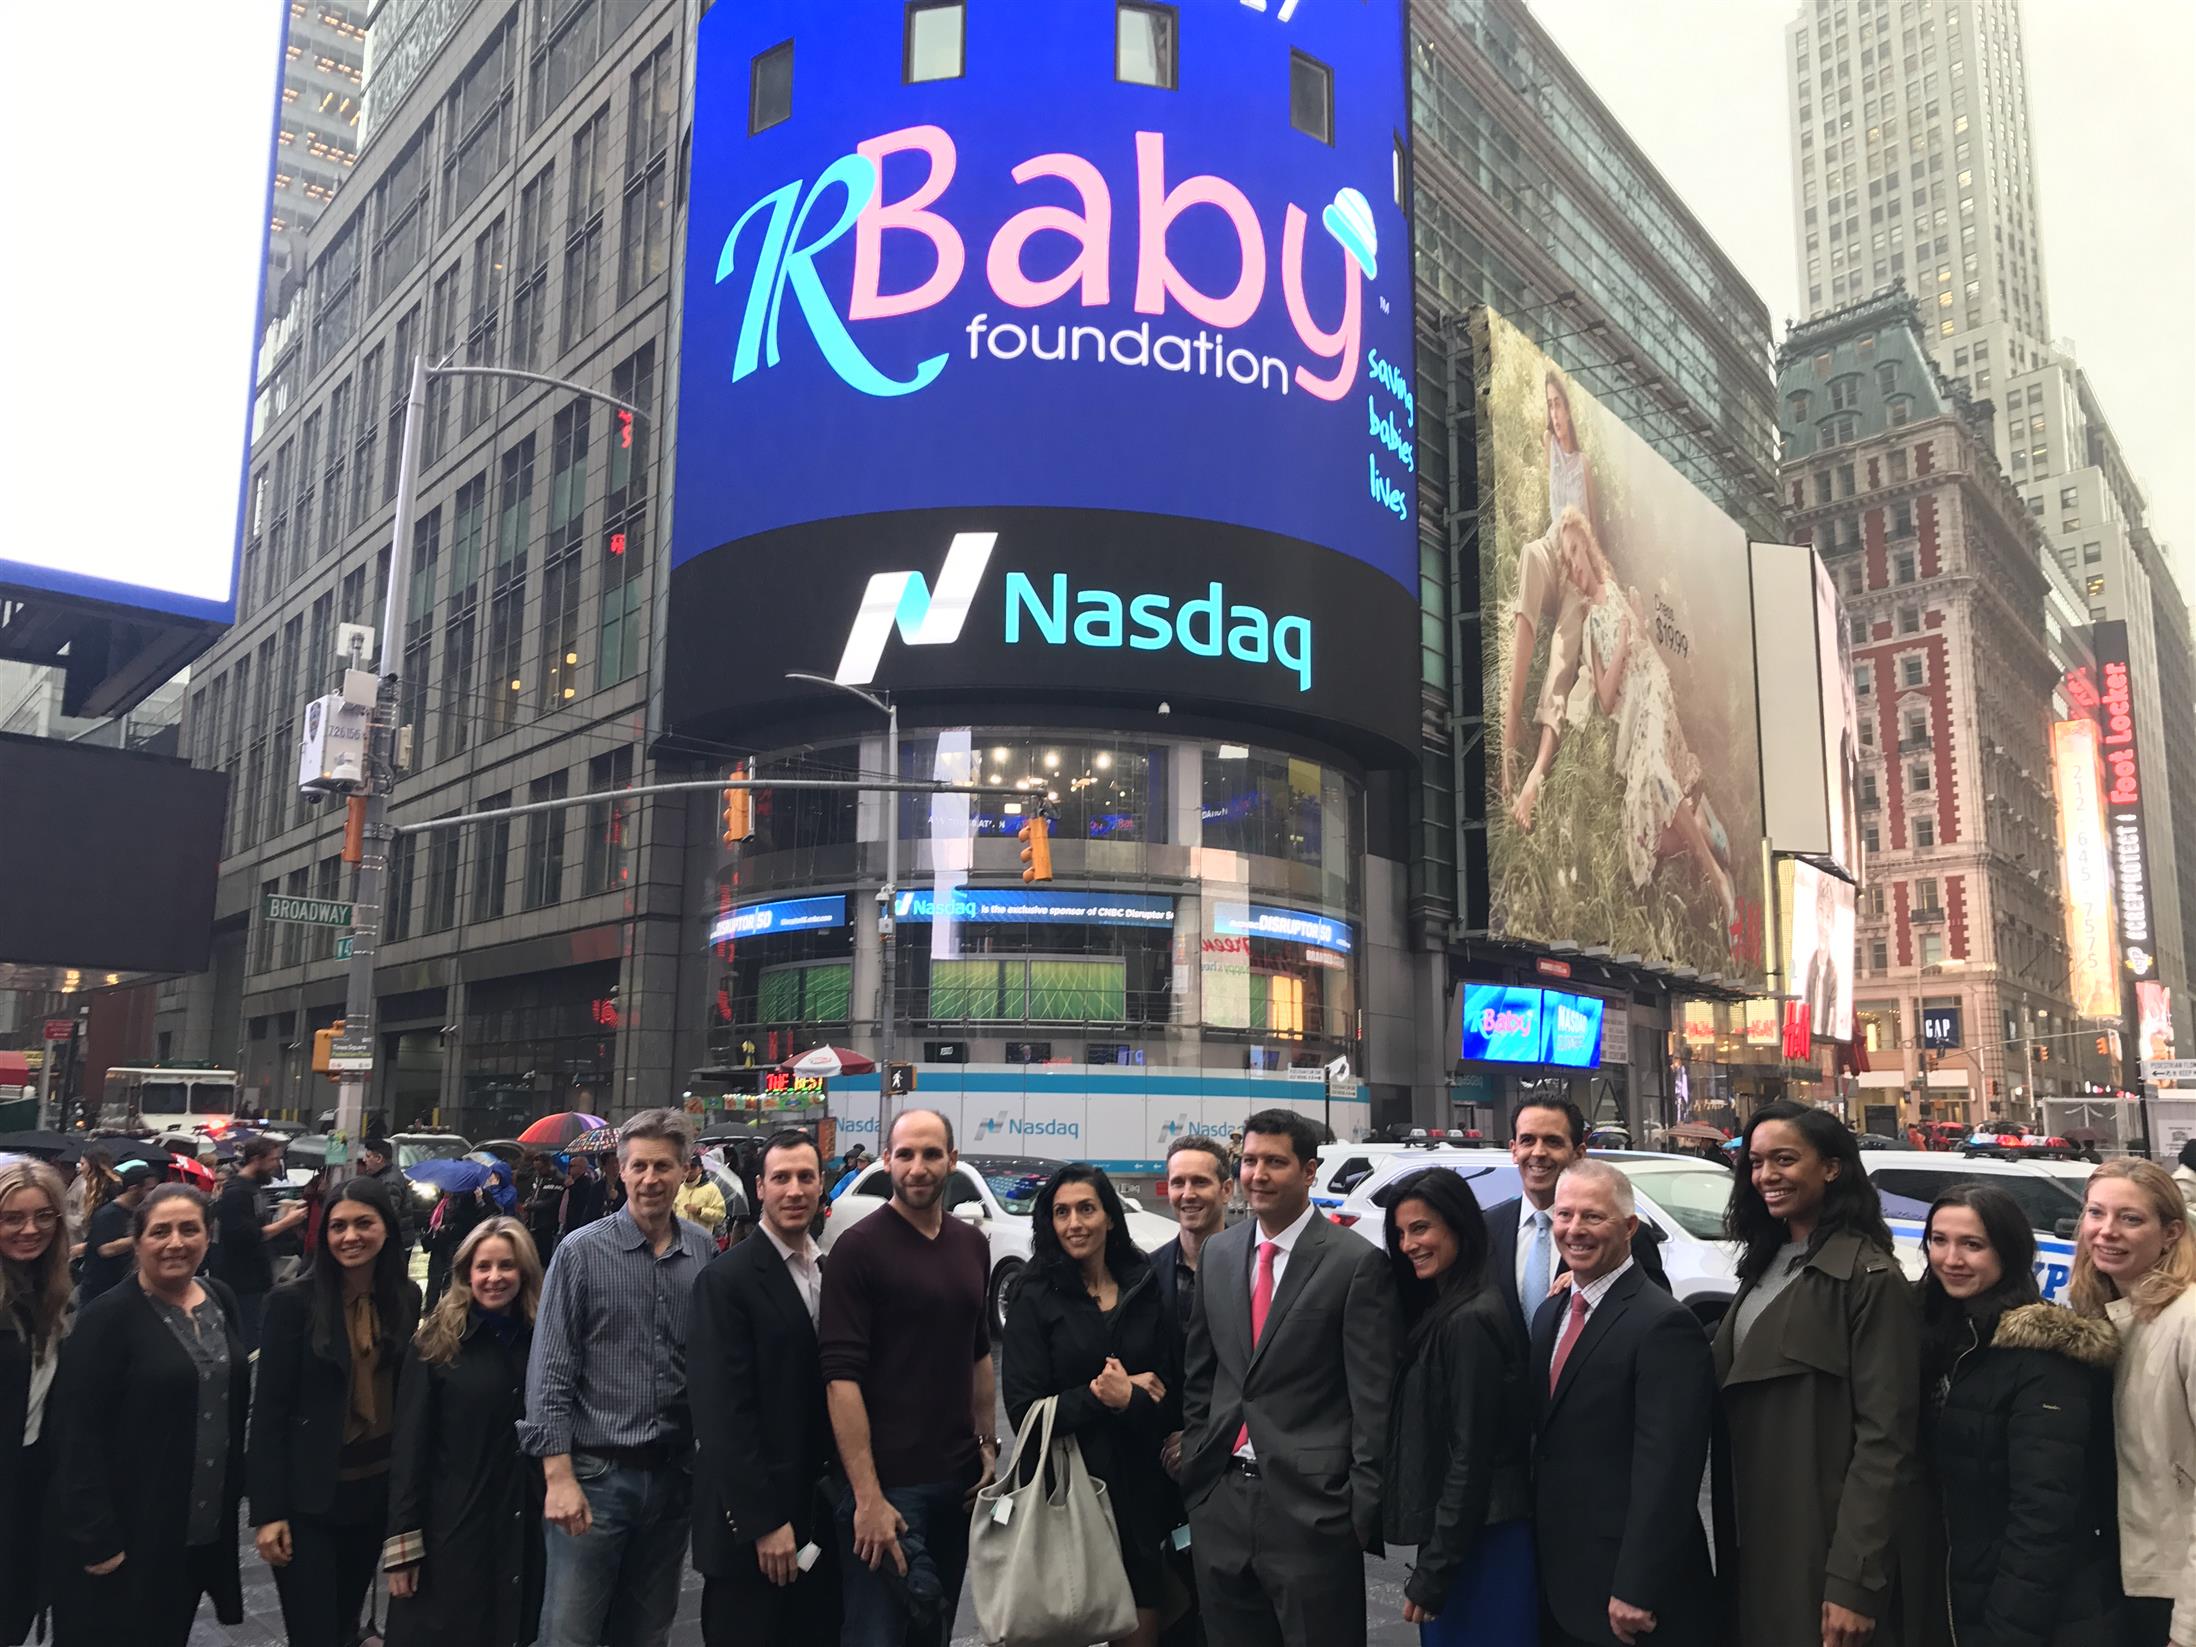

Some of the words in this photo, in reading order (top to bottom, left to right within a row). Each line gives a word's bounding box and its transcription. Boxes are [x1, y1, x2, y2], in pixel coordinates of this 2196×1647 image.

[965, 313, 1289, 395] foundation
[1368, 348, 1414, 428] saving
[1368, 394, 1414, 473] babies
[1369, 452, 1407, 520] lives
[1005, 572, 1311, 691] Nasdaq
[1656, 616, 1688, 659] $19.99
[2102, 661, 2133, 744] Locker
[2108, 748, 2138, 804] Foot
[270, 900, 349, 924] BROADWAY
[913, 900, 976, 918] Nasdaq
[1007, 905, 1048, 915] exclusive
[1050, 906, 1085, 917] sponsor
[1086, 907, 1097, 916] of
[1098, 907, 1125, 918] CNBC
[1125, 908, 1165, 920] Disruptor
[1259, 914, 1318, 939] DISRUPTOR
[1925, 1018, 1951, 1038] GAP
[766, 1072, 789, 1091] THE
[836, 1116, 881, 1132] Nasda
[1009, 1118, 1079, 1138] Nasdaq
[1188, 1120, 1246, 1137] Nasda
